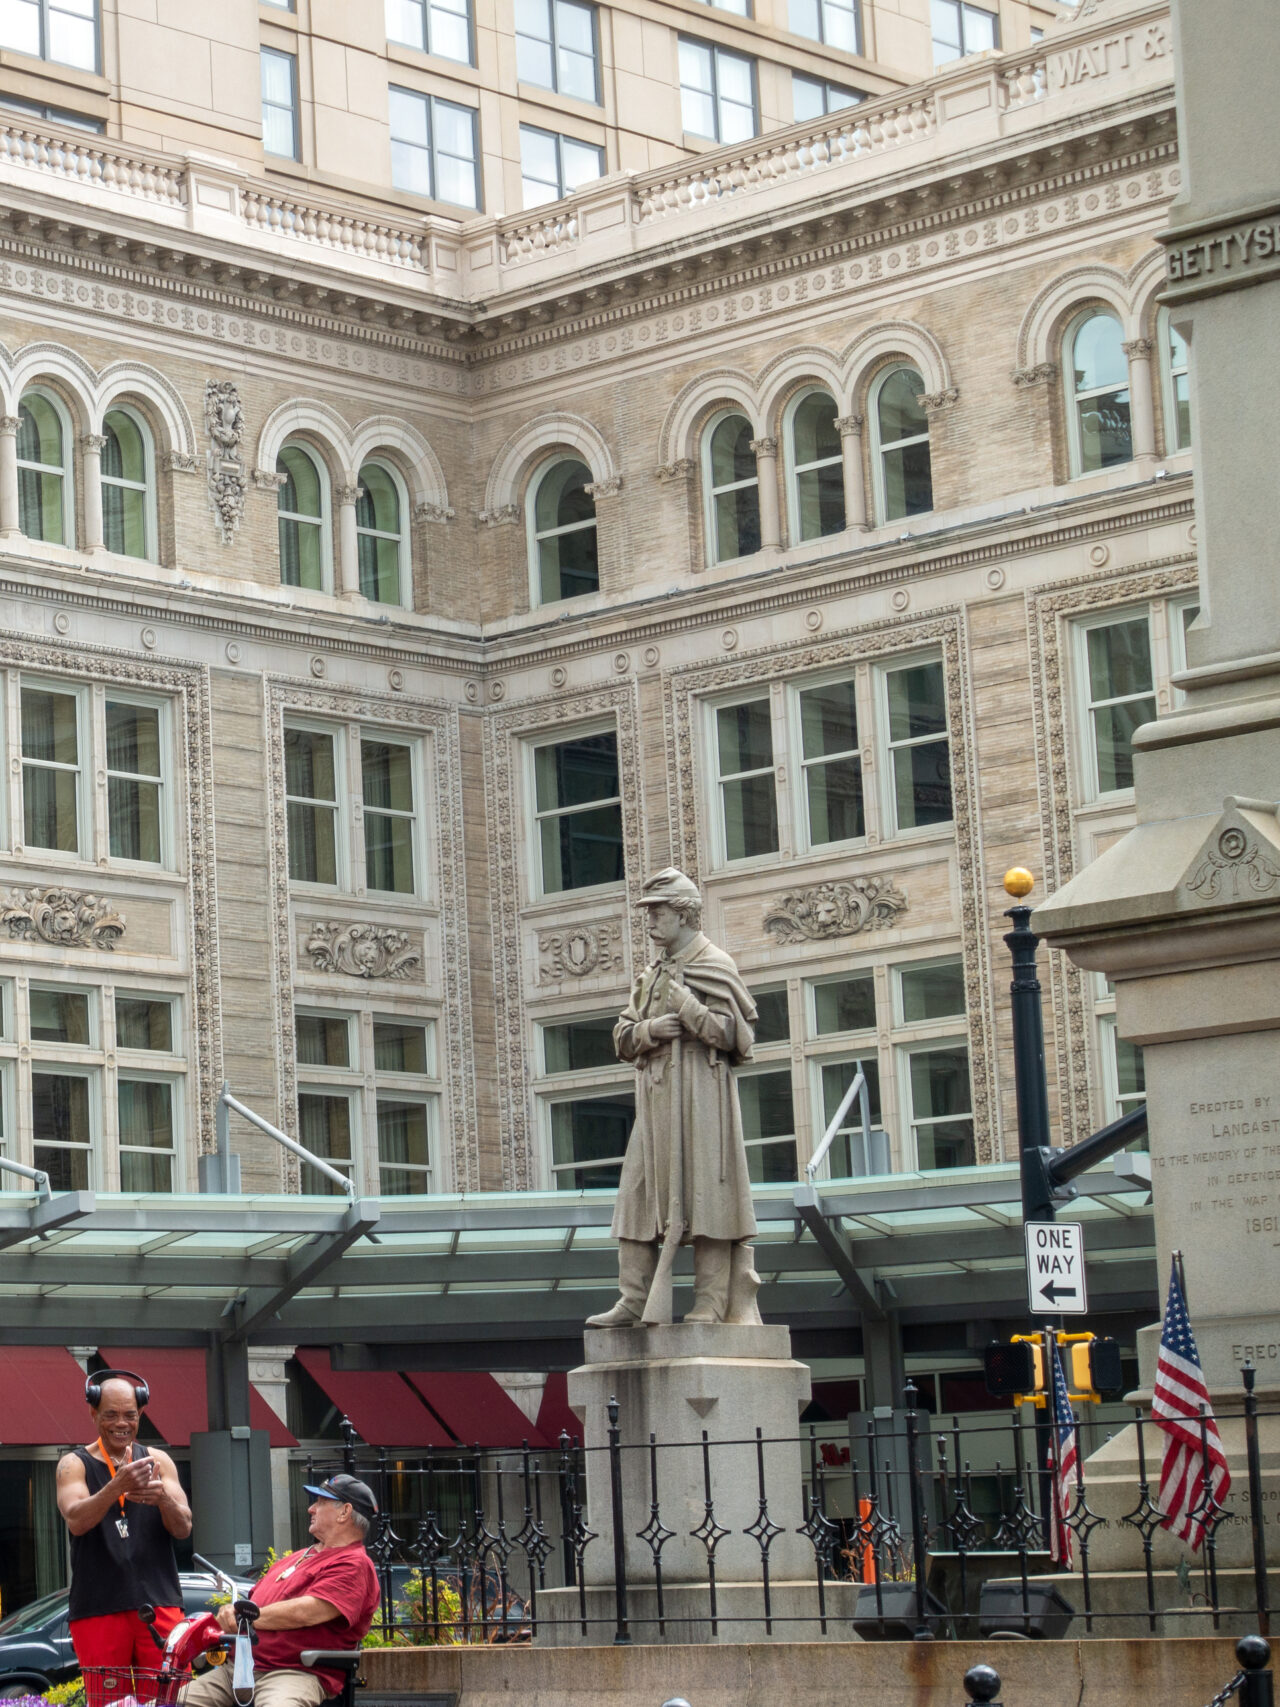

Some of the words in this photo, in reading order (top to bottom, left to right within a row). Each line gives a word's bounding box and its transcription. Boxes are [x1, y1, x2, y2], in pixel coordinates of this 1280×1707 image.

[1057, 34, 1134, 88] WATT
[1190, 1099, 1244, 1115] ERECTED
[1254, 1097, 1270, 1108] BY
[1152, 1157, 1165, 1168] TO
[1169, 1155, 1189, 1166] THE
[1193, 1150, 1239, 1164] MEMORY
[1244, 1148, 1257, 1158] OF
[1211, 1199, 1233, 1210] THE
[1037, 1229, 1072, 1248] ONE
[1037, 1255, 1074, 1274] WAY
[1232, 1344, 1280, 1361] EREC
